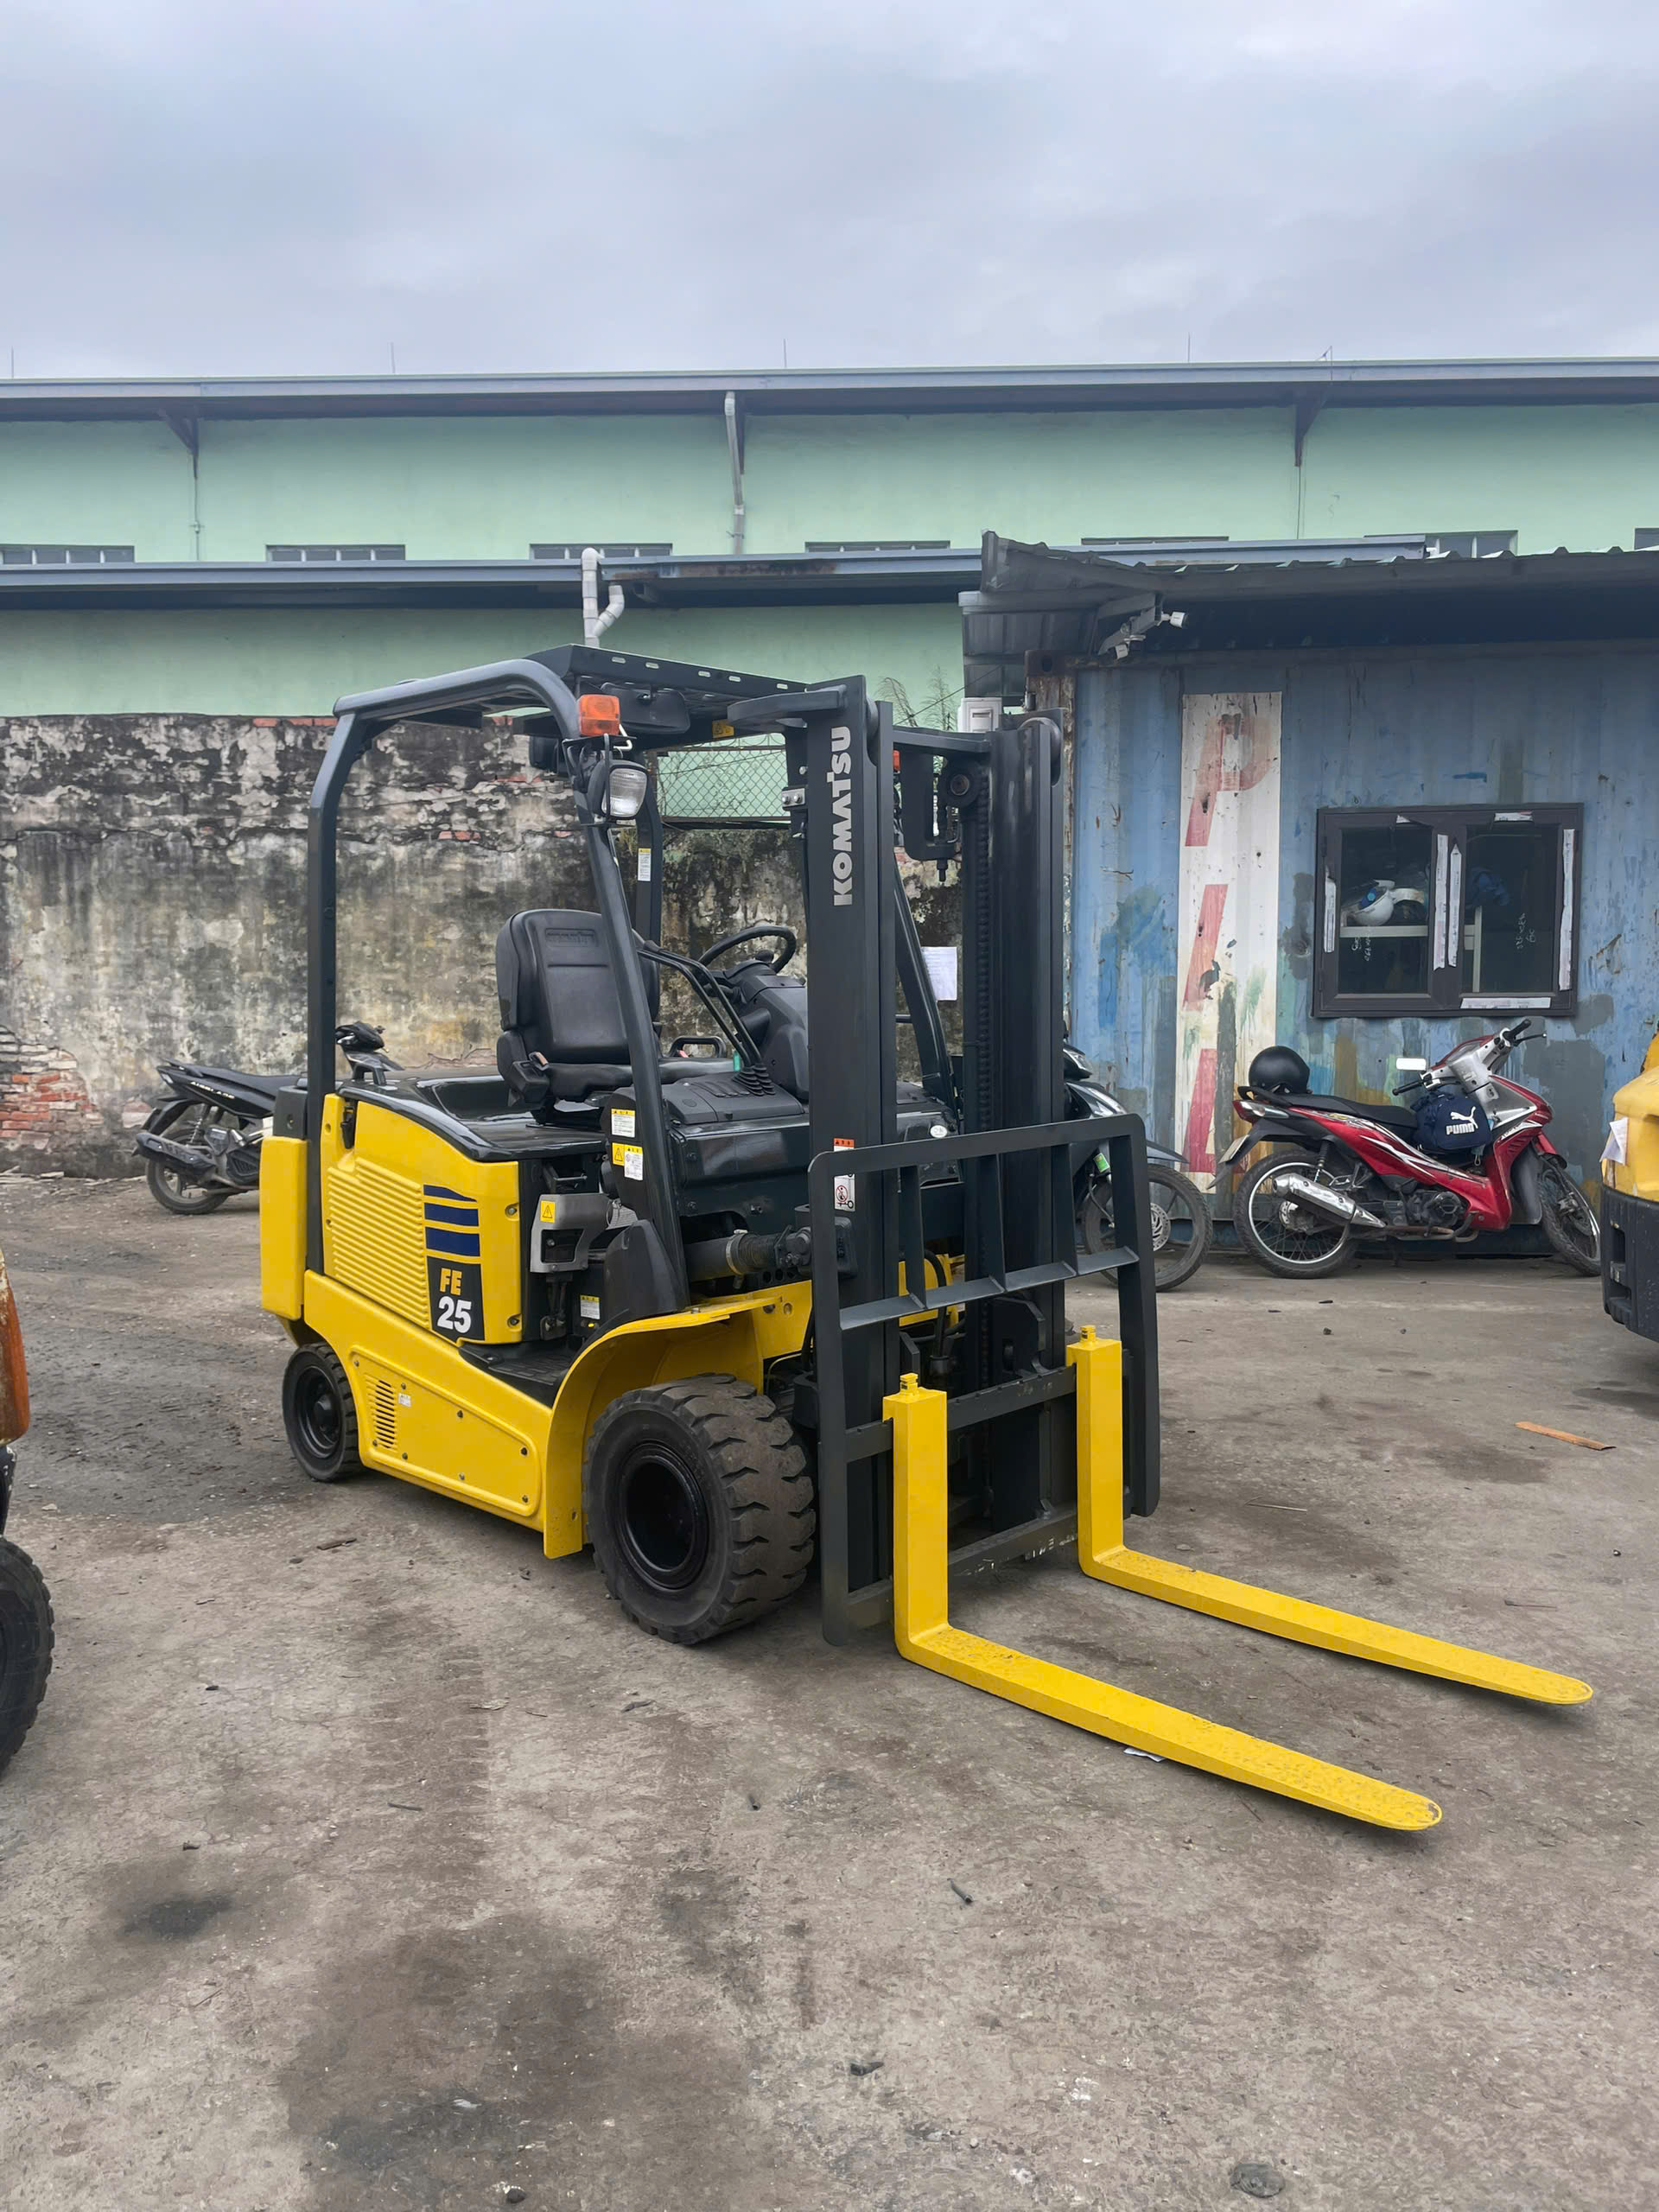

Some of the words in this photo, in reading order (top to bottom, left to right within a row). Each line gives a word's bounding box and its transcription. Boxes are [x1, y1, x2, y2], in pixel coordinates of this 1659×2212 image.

[826, 726, 853, 906] KOMATSU
[1446, 1122, 1475, 1135] PUMA
[439, 1268, 462, 1295] FE
[436, 1295, 472, 1333] 25
